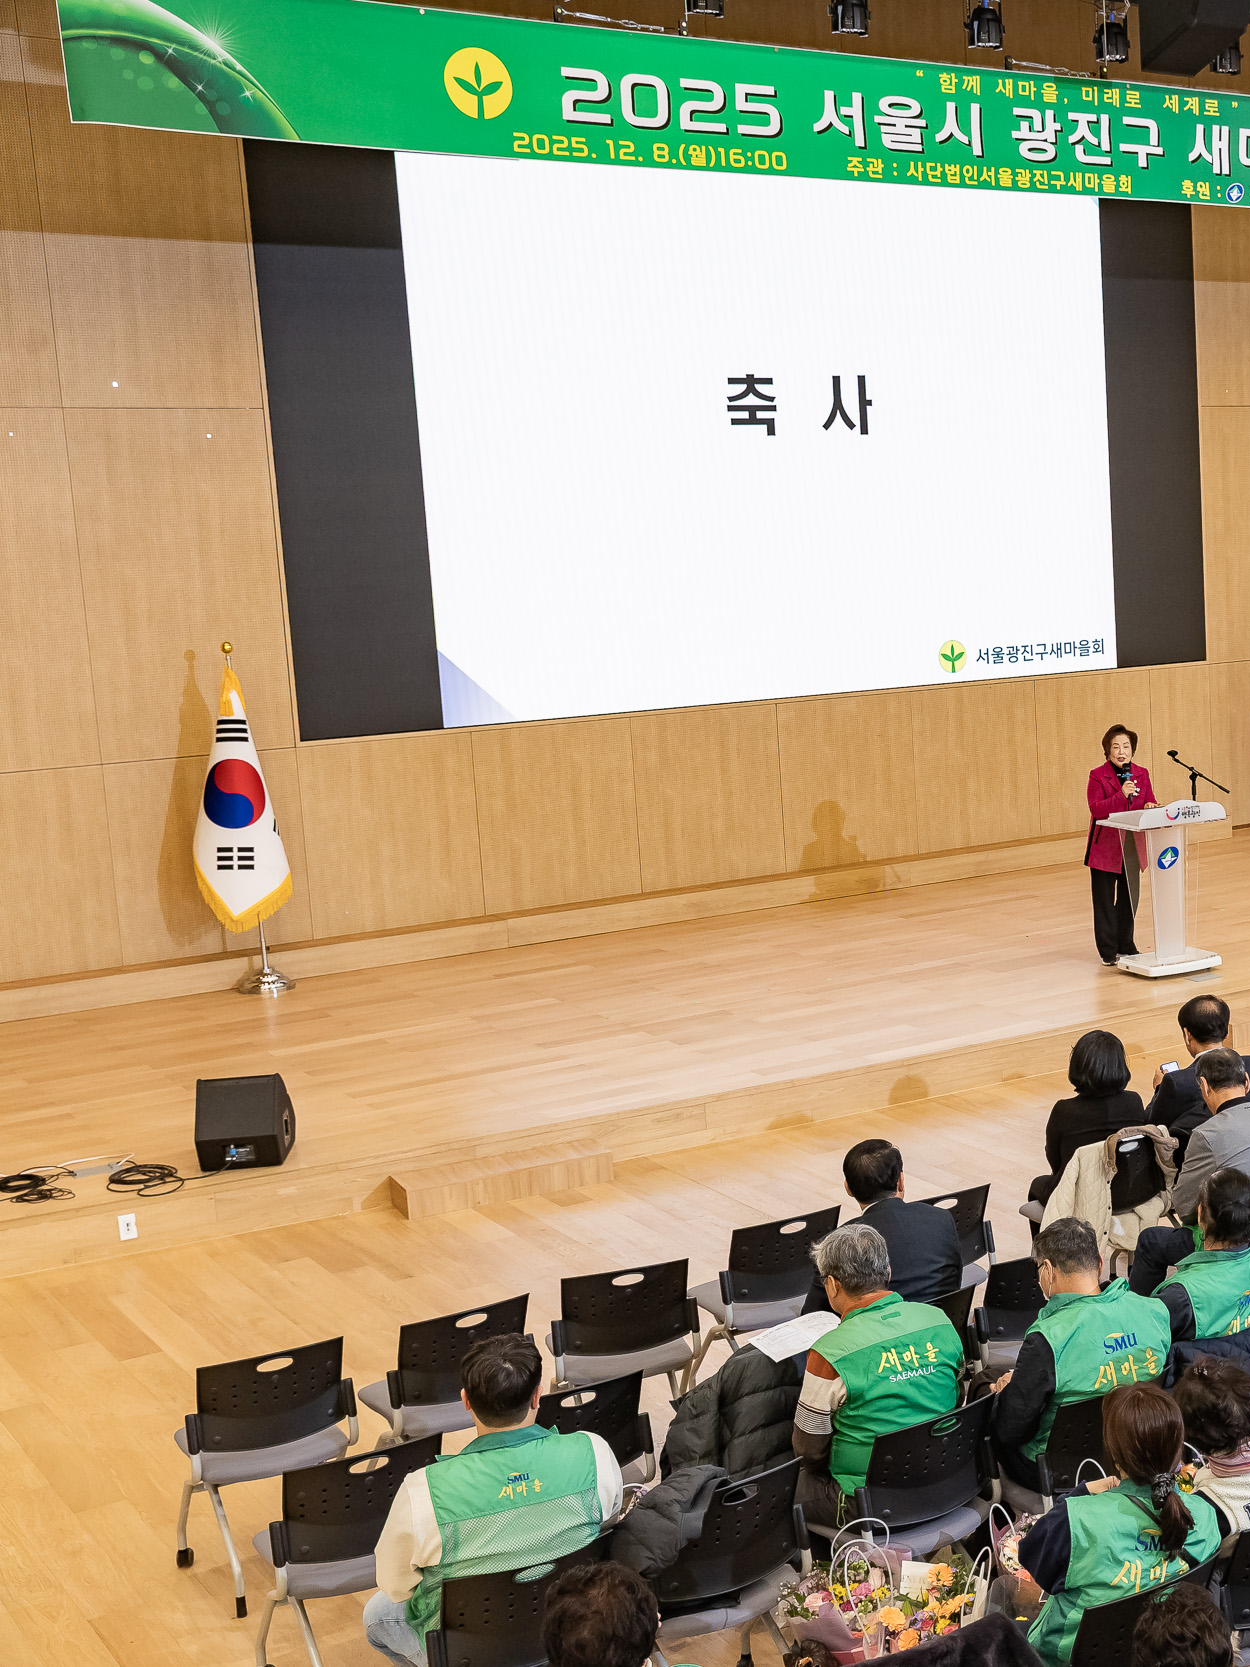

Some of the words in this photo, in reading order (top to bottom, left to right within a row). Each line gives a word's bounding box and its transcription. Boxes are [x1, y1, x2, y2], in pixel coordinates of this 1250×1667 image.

[938, 72, 982, 96] 함께
[994, 78, 1069, 105] 새마을,
[1081, 84, 1143, 109] 미래로
[1162, 94, 1221, 117] 세계로
[560, 66, 783, 138] 2025
[812, 89, 985, 158] 서울시
[1010, 106, 1165, 170] 광진구
[512, 131, 597, 159] 2025.
[605, 138, 644, 162] 12.
[652, 142, 788, 171] 8.(월)16:00
[846, 156, 885, 179] 주관
[905, 160, 1133, 195] 사단법인서울광진구새마을회
[1181, 178, 1211, 201] 후원
[726, 374, 777, 436] 축
[822, 374, 873, 436] 사
[975, 638, 1105, 665] 서울광진구새마을회
[877, 1341, 940, 1374] 새마을
[1103, 1332, 1138, 1355] SMU
[889, 1365, 937, 1383] SAEMAUL
[1094, 1347, 1159, 1389] 새마을
[498, 1478, 543, 1500] 새마을
[506, 1472, 530, 1485] SMU
[1134, 1530, 1163, 1552] SM
